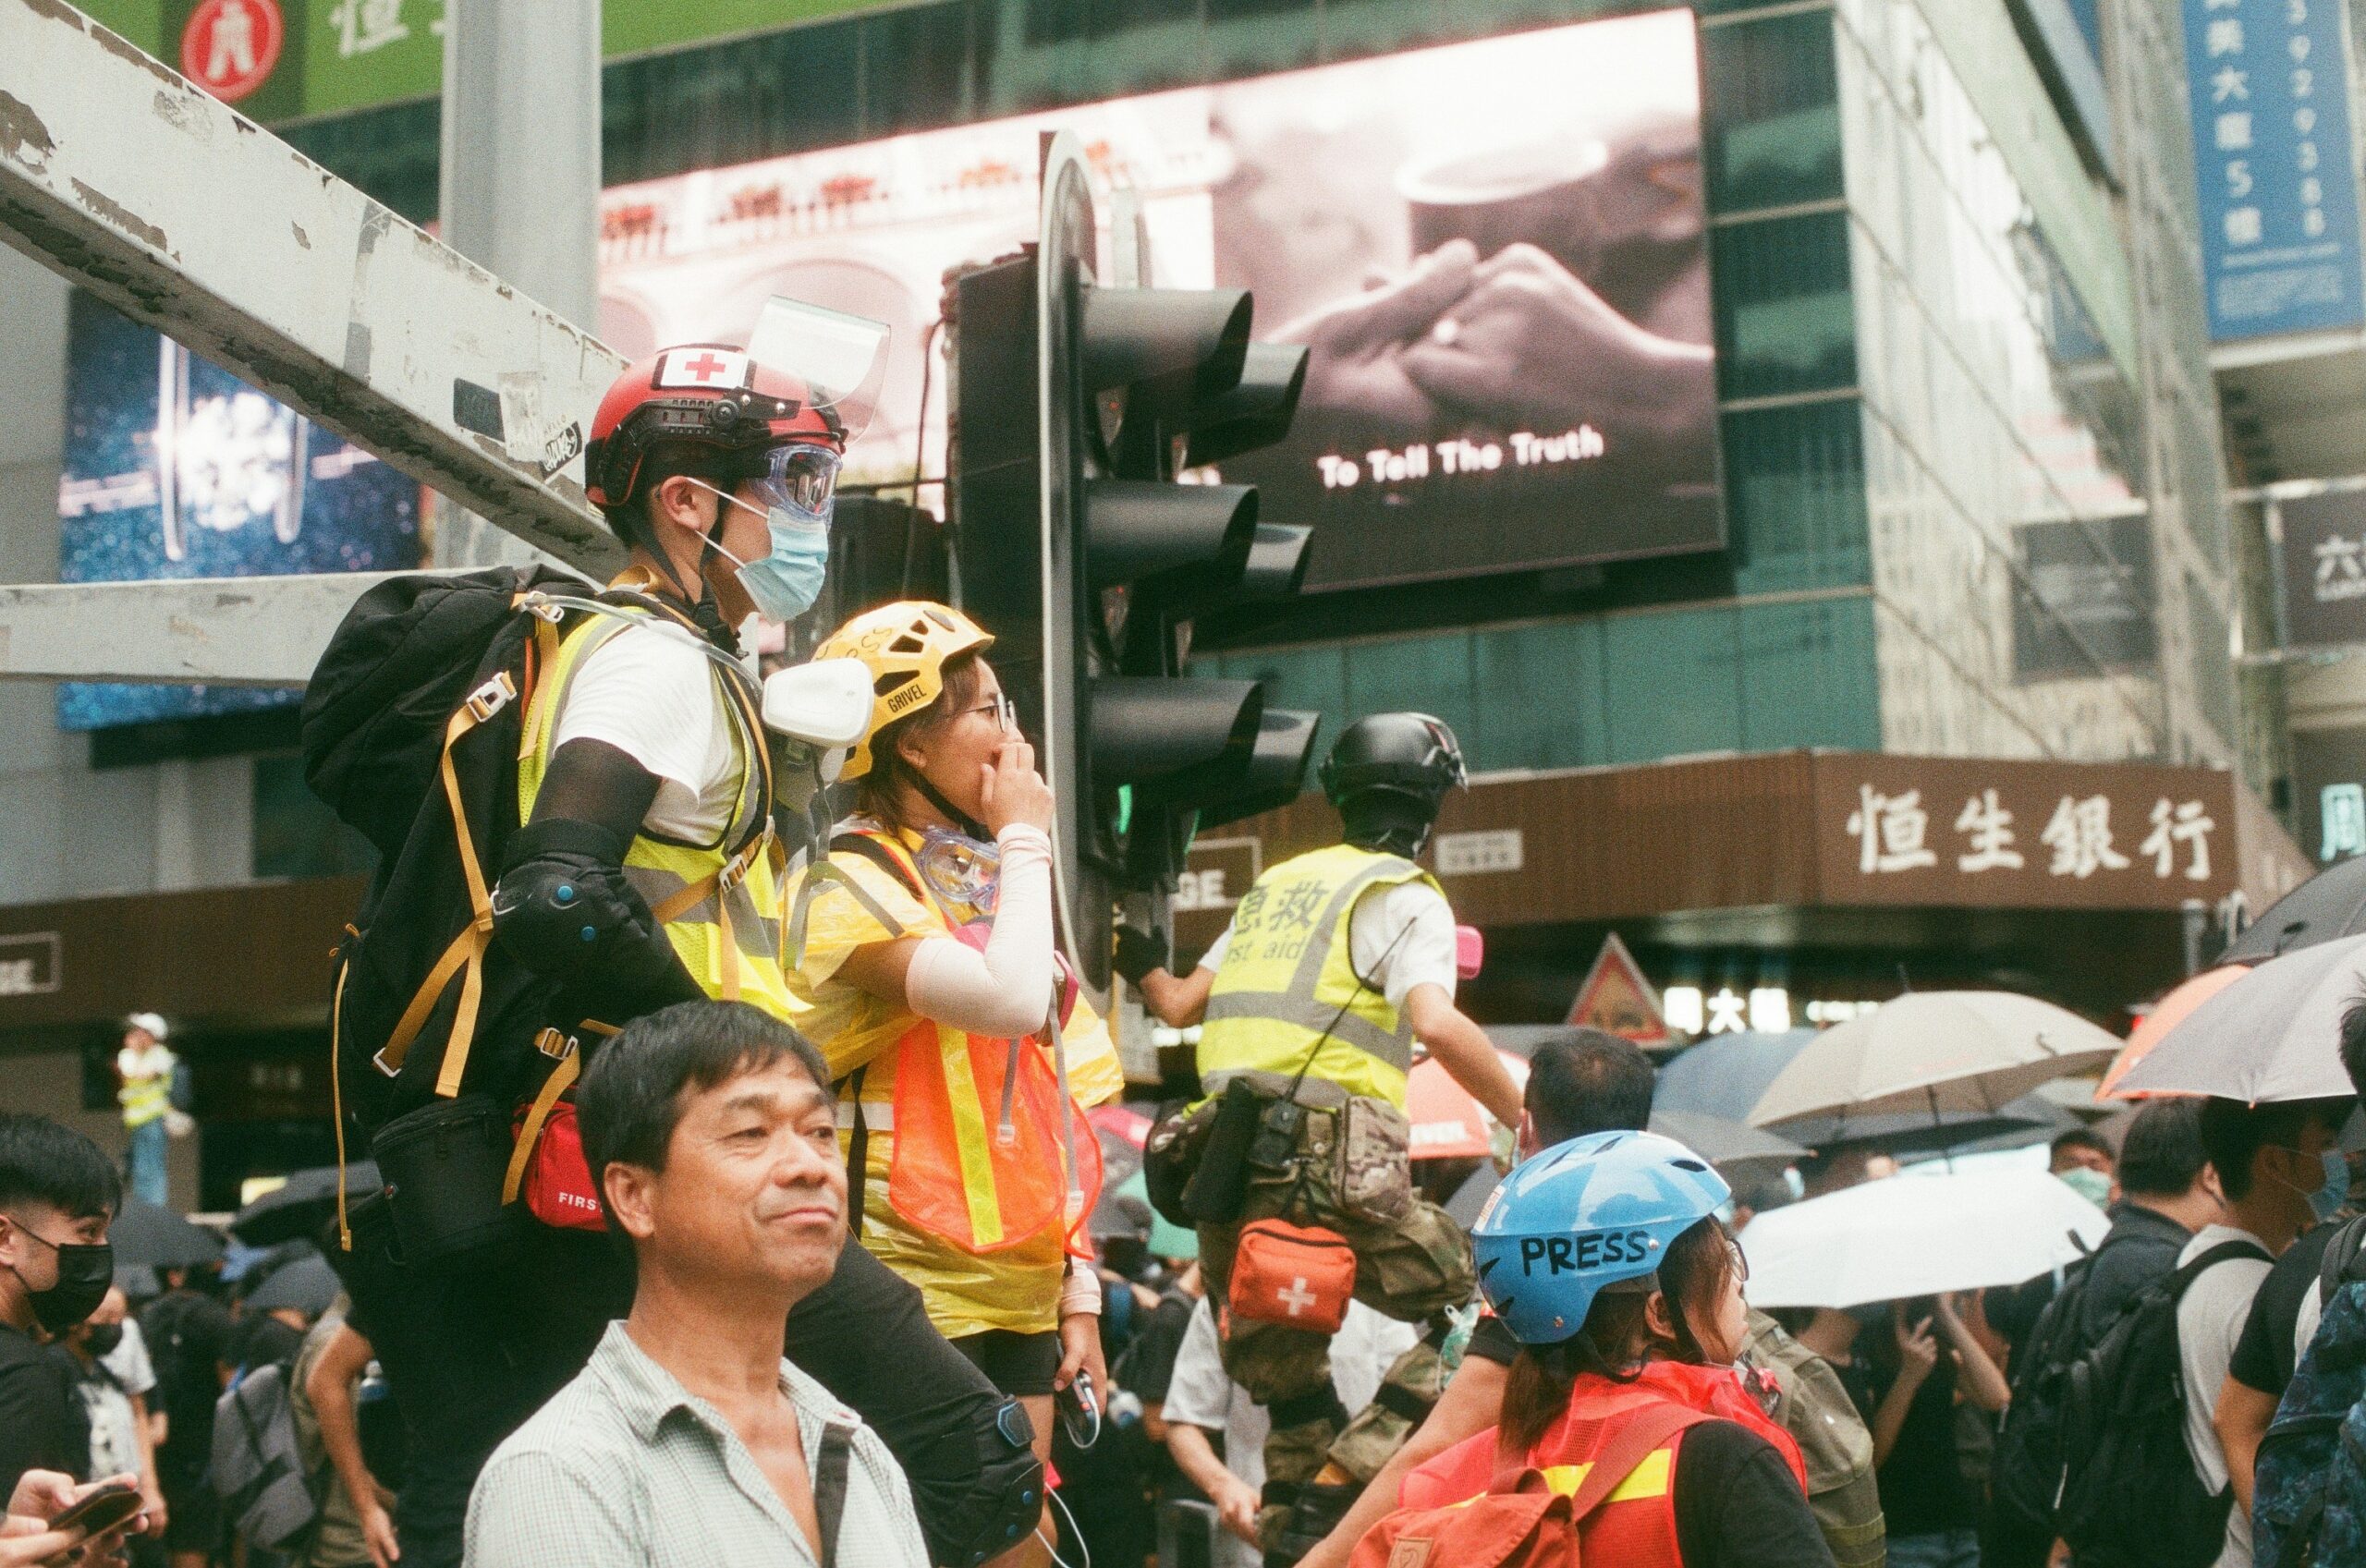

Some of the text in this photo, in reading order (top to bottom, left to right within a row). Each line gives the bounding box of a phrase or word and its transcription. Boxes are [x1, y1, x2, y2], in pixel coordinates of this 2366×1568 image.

[1317, 423, 1604, 489] To Tell The Truth
[887, 684, 927, 713] GRIVEL
[1847, 783, 2215, 881] 恒生銀行
[1236, 881, 1328, 934] 急救
[1263, 933, 1309, 959] aid
[558, 1191, 604, 1213] FIRS
[1520, 1230, 1650, 1277] PRESS
